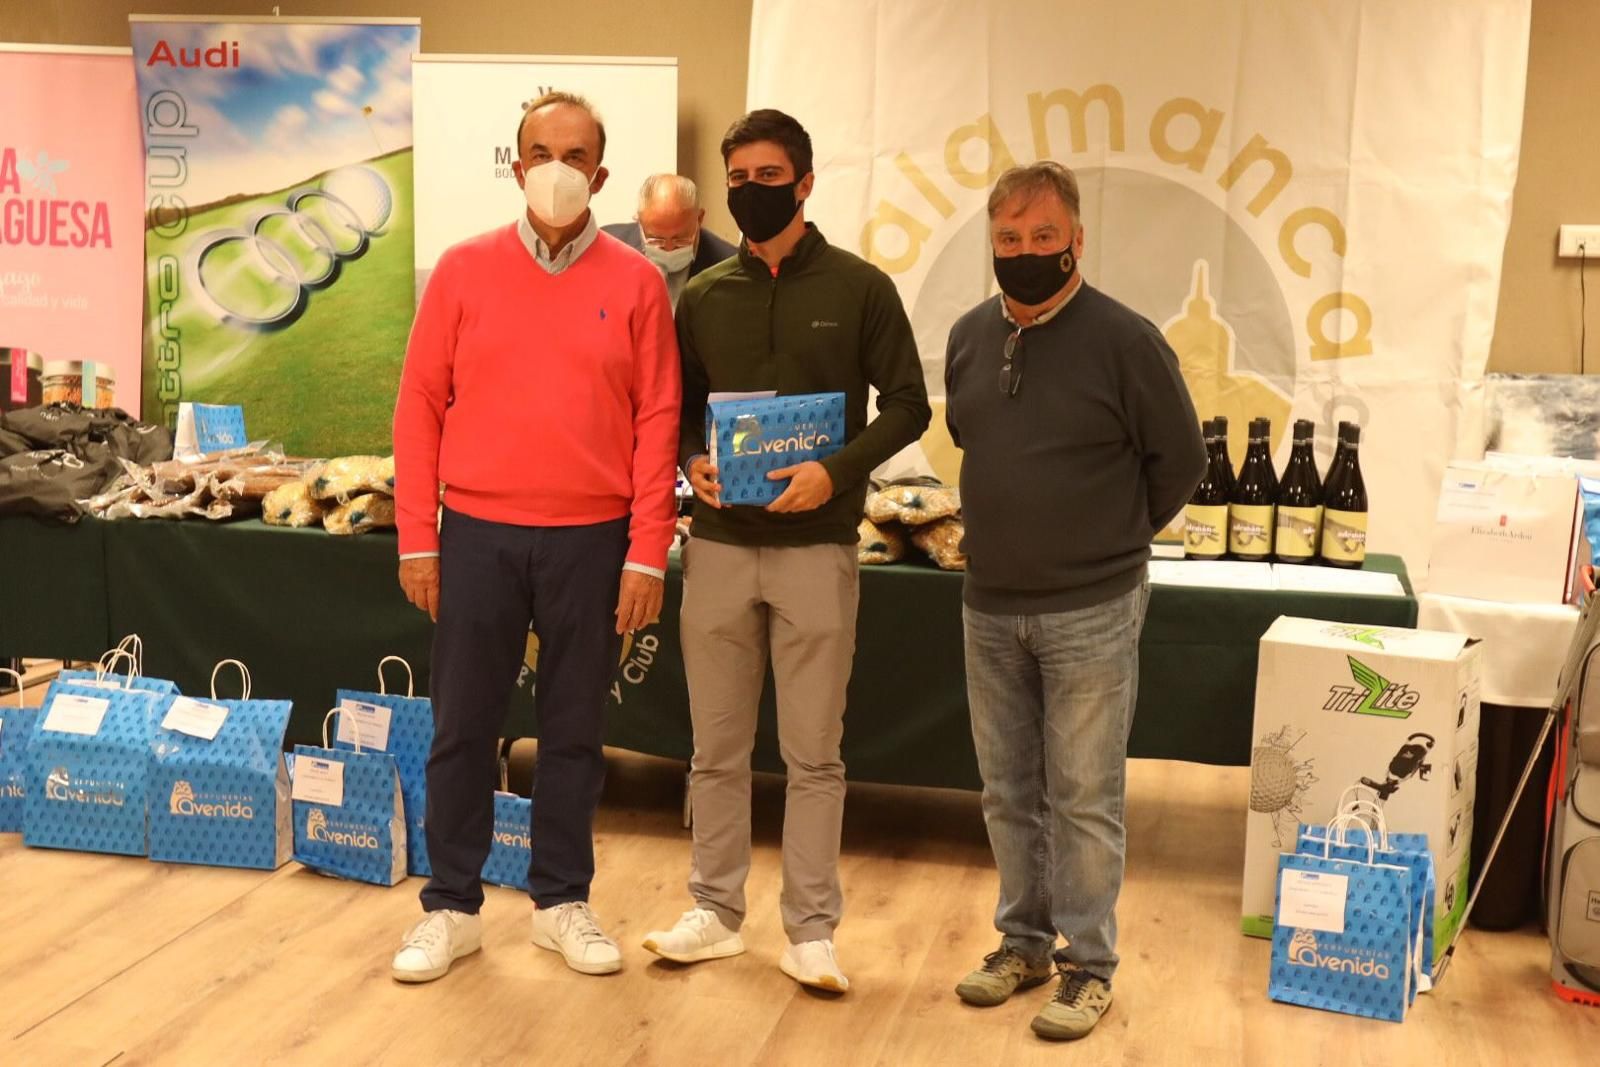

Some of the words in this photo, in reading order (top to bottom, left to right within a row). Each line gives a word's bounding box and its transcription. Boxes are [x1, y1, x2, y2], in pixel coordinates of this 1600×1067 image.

[147, 41, 239, 68] Audi
[146, 90, 198, 239] cup
[0, 199, 112, 248] GUESA
[860, 83, 1373, 361] alamanca
[623, 634, 660, 685] Club
[178, 799, 253, 820] avenida
[314, 825, 379, 849] avenida
[494, 831, 532, 849] veni
[1298, 946, 1390, 979] avenida
